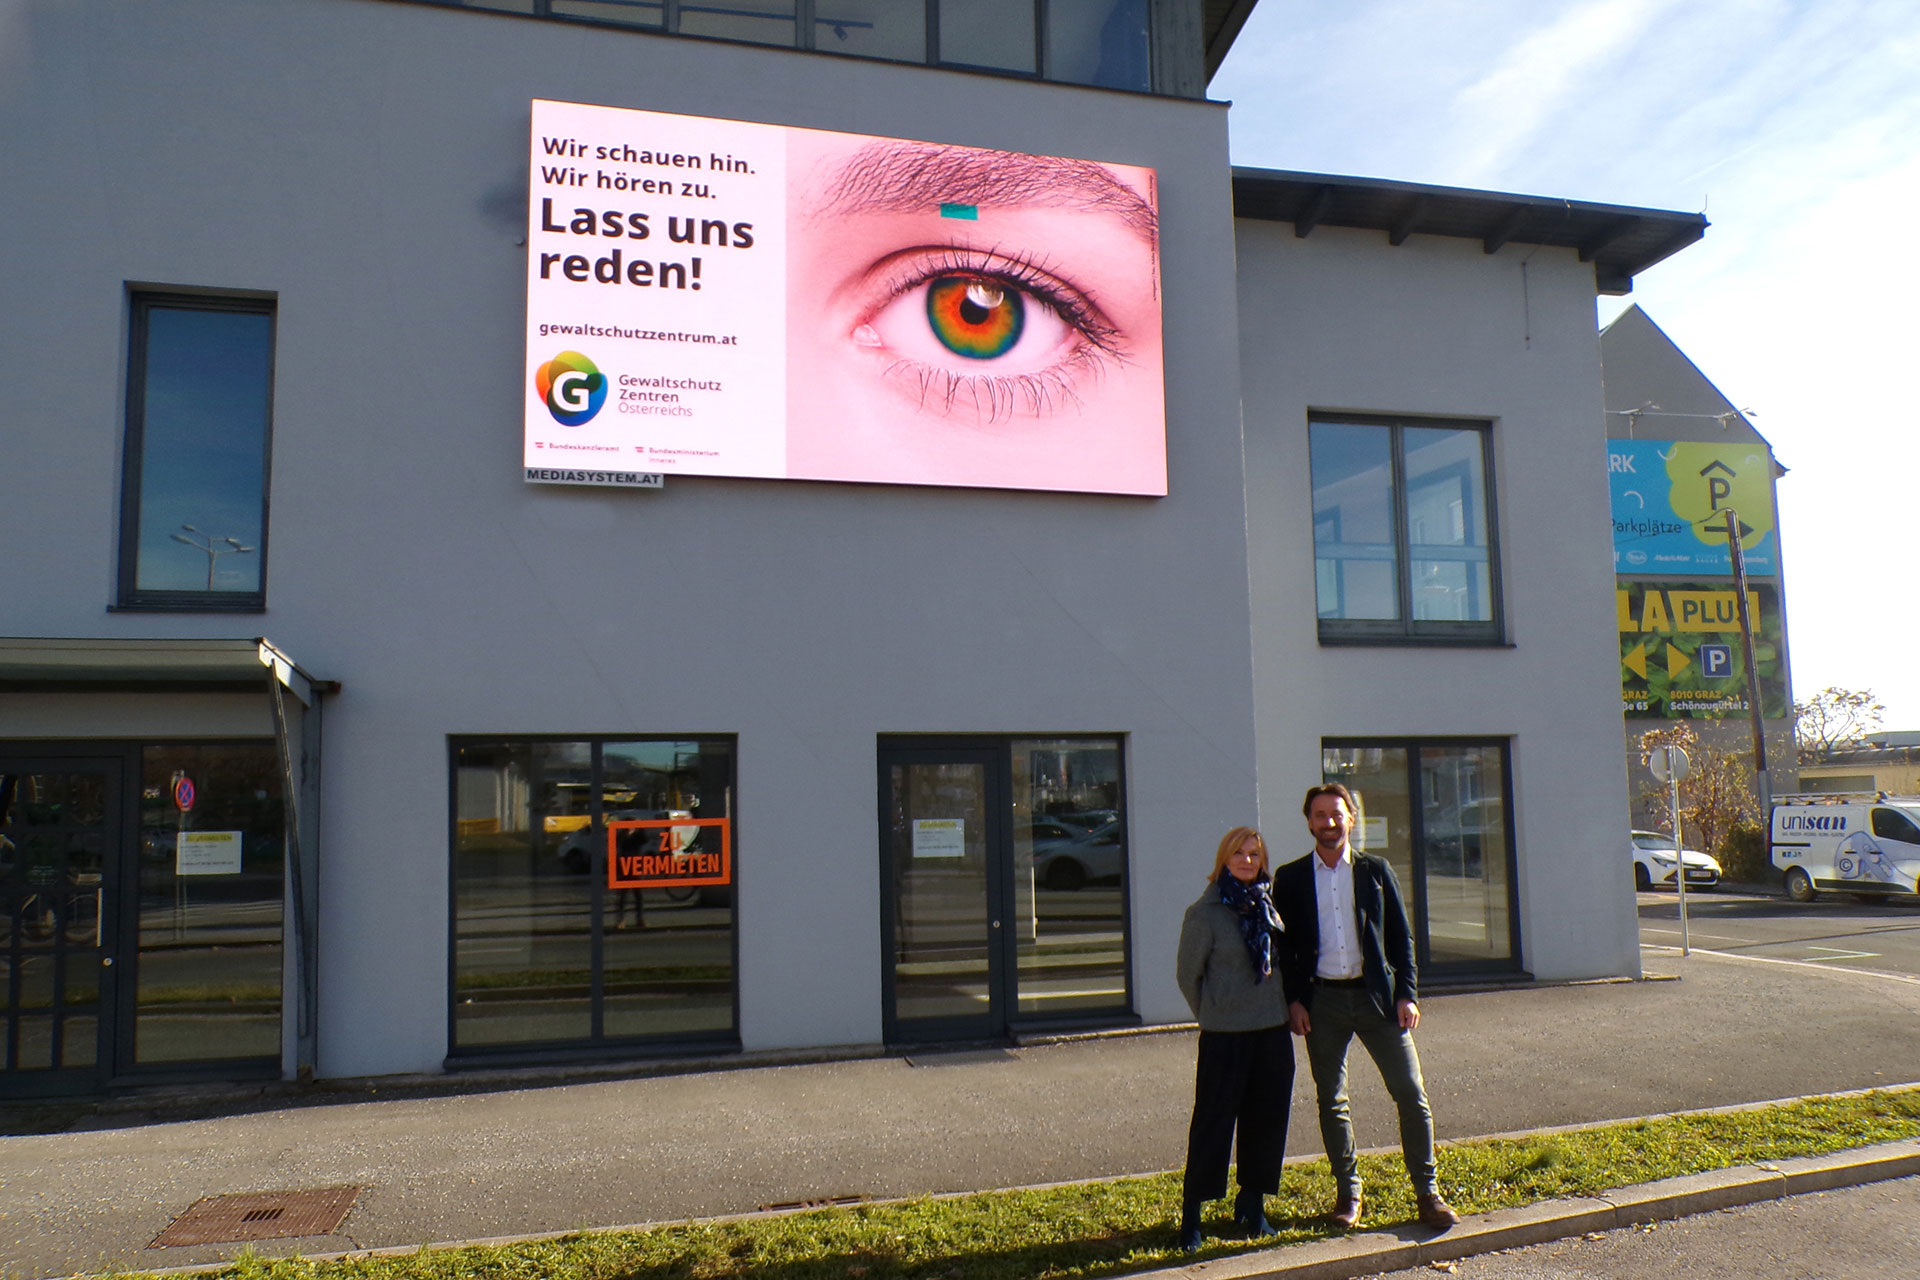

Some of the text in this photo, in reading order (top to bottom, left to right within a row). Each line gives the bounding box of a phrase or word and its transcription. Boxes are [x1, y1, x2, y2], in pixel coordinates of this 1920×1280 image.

[542, 136, 756, 175] Wir schauen hin.
[541, 166, 716, 199] Wir hören zu.
[541, 197, 754, 249] Lass uns
[540, 248, 702, 291] reden!
[539, 323, 738, 345] gewaltschutzzentrum.at
[552, 370, 590, 412] G
[619, 374, 722, 391] Gewaltschutz
[619, 388, 679, 403] Zentren
[549, 442, 620, 452] Bundeskanzleramt
[649, 447, 720, 457] Bundesministerium
[1608, 454, 1637, 473] RK
[527, 469, 660, 485] MEDIASYSTEM.AT
[1709, 477, 1731, 510] P
[1683, 600, 1739, 623] PLU
[1709, 650, 1726, 672] P
[1670, 690, 1722, 699] 8010 GRAZ
[1637, 701, 1648, 710] 65
[1743, 701, 1749, 710] 2
[1782, 810, 1847, 830] unisan
[659, 831, 682, 852] ZU
[620, 853, 720, 876] VERMIETEN
